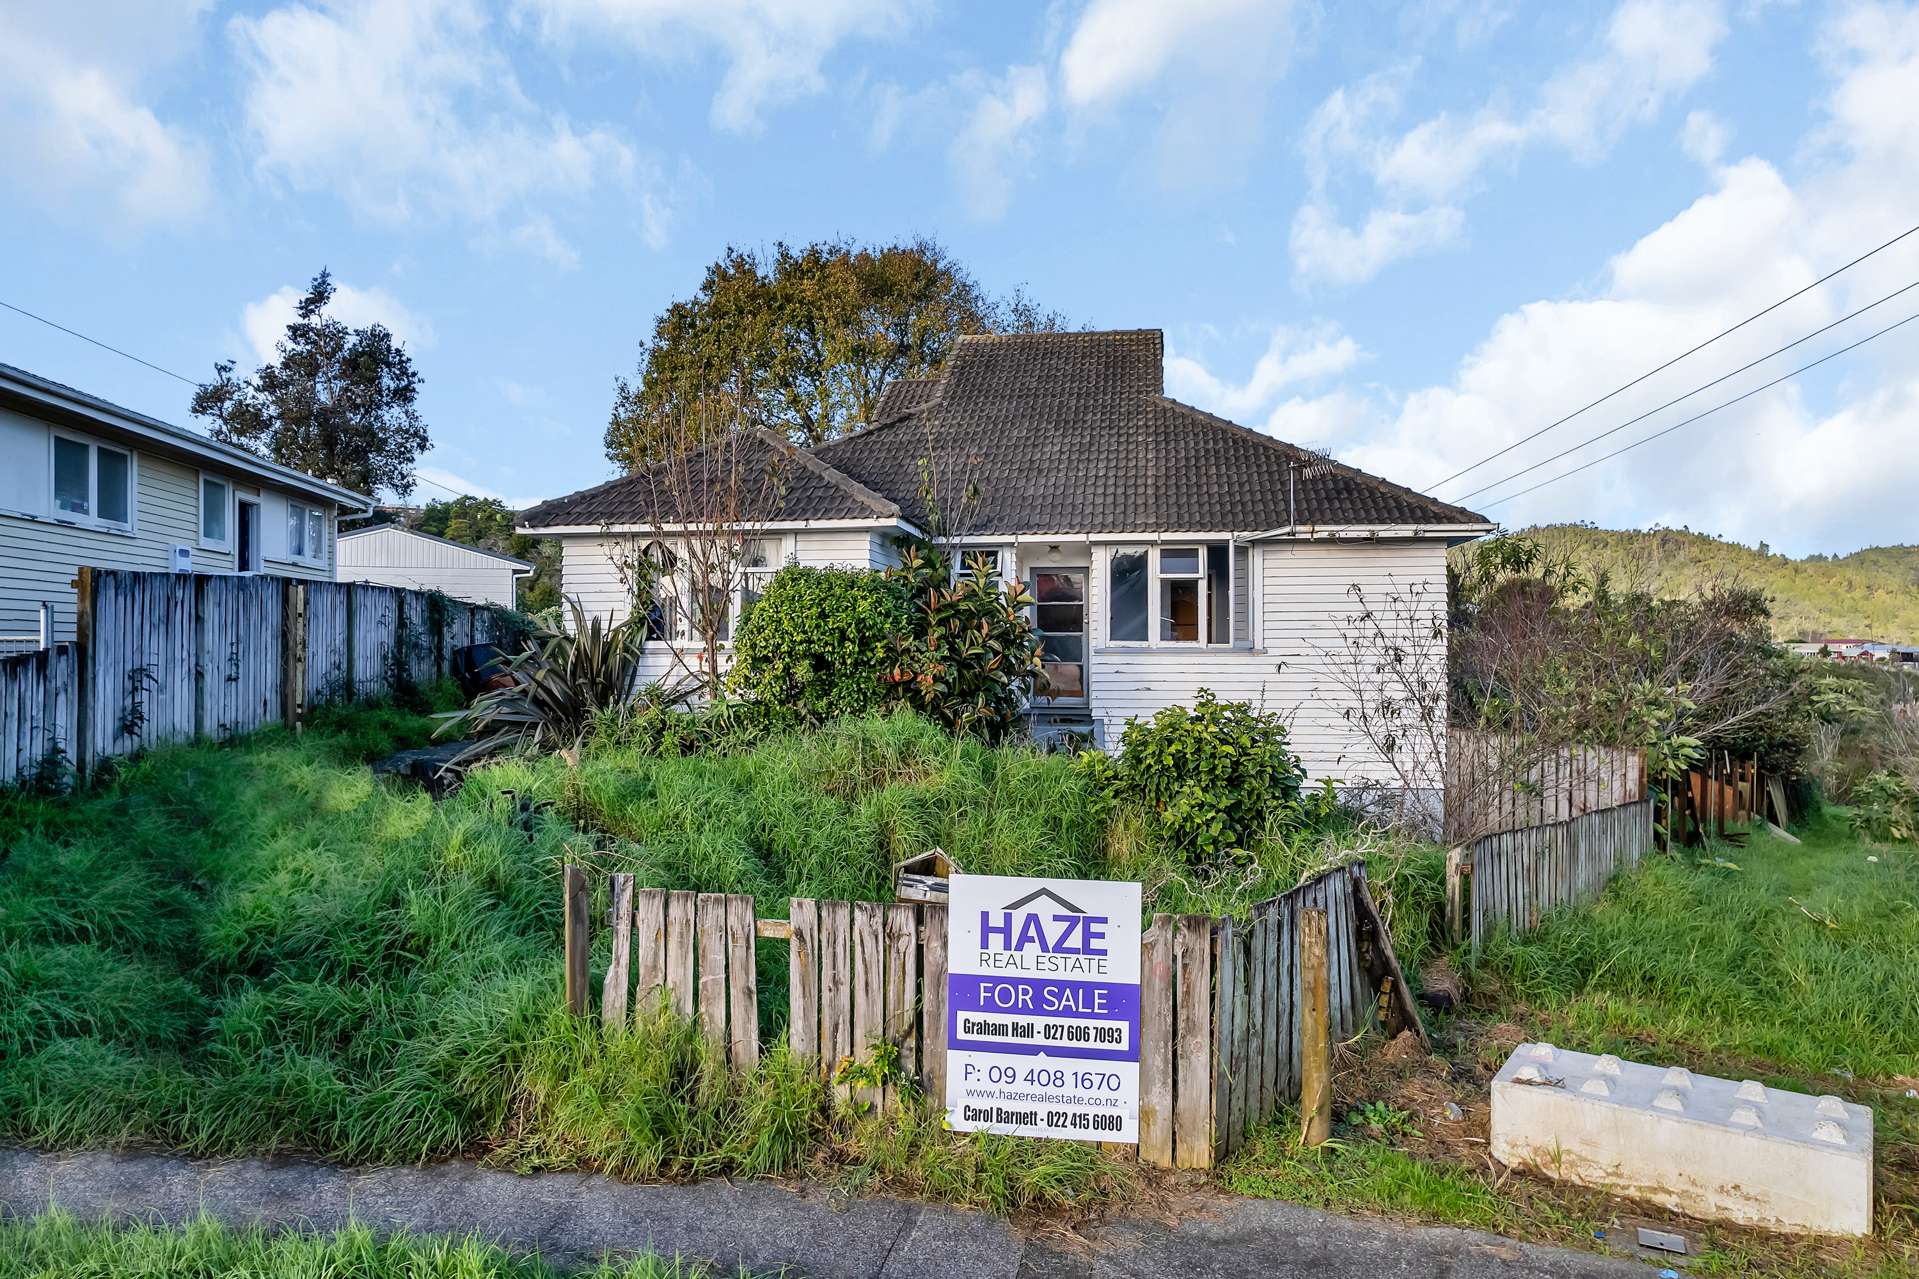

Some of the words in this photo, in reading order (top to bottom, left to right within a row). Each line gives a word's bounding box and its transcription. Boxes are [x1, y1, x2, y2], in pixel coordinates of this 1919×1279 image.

[980, 911, 1109, 956] HAZE
[979, 952, 1030, 970] REAL
[1036, 955, 1108, 975] ESTATE
[979, 982, 1034, 1009] FOR
[1042, 986, 1109, 1014] SALE
[963, 1018, 1009, 1037] Graham
[1011, 1021, 1035, 1039] Hall
[1043, 1023, 1064, 1041] 027
[1067, 1025, 1090, 1042] 606
[1093, 1026, 1122, 1044] 7093
[964, 1063, 981, 1082] P:
[988, 1065, 1016, 1085] 09
[1023, 1068, 1065, 1088] 408
[1071, 1071, 1121, 1092] 1670
[966, 1088, 1119, 1107] www.hazerealestate.co.nz
[963, 1104, 993, 1123] Carol
[996, 1107, 1038, 1126] Barnett
[1046, 1111, 1068, 1129] 022
[1070, 1112, 1090, 1130] 415
[1092, 1114, 1122, 1132] 6080
